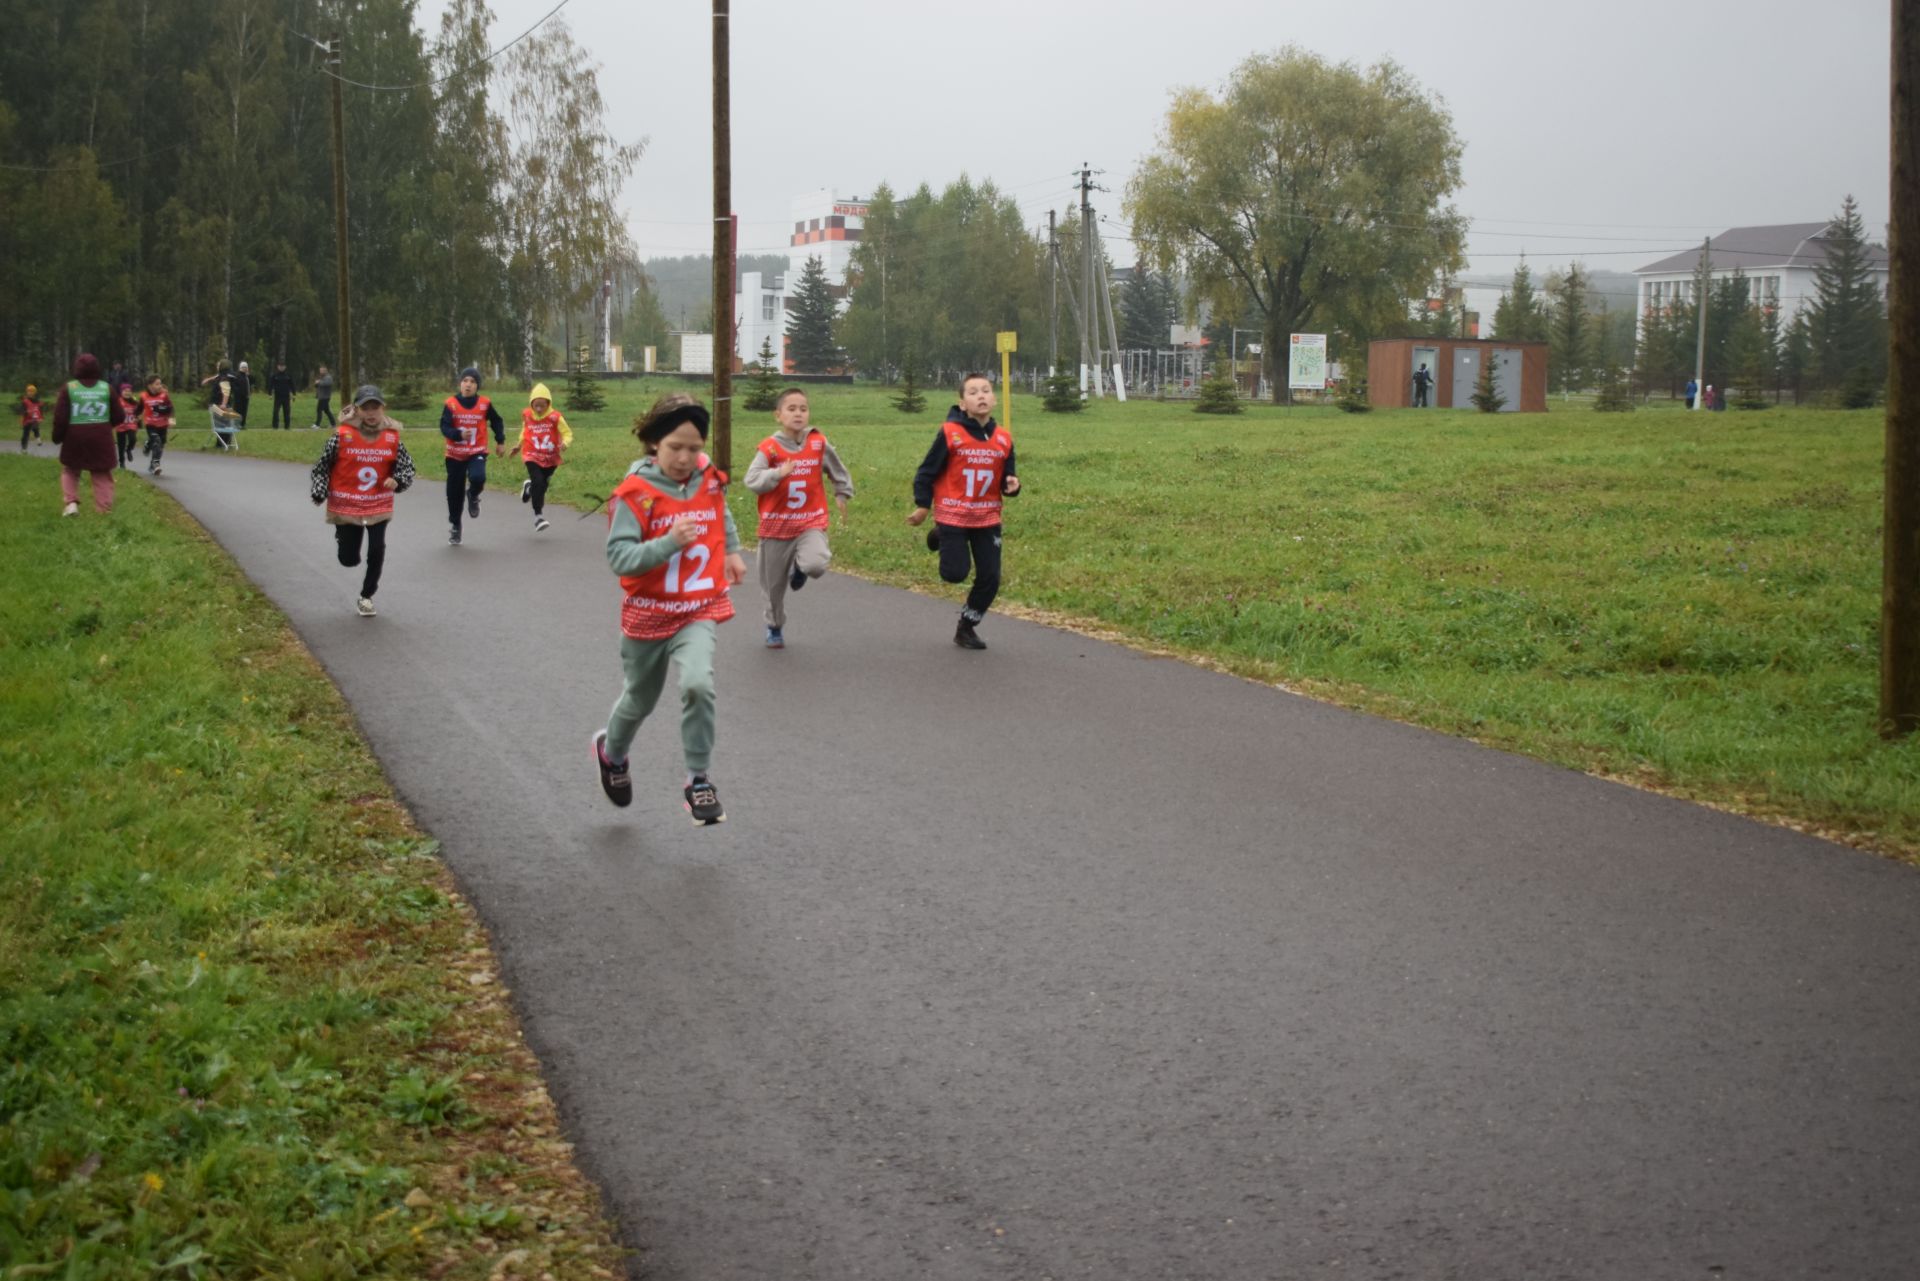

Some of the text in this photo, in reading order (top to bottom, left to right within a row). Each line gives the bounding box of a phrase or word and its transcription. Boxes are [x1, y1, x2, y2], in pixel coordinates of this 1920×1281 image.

[72, 401, 107, 417] 147
[531, 434, 555, 451] 14
[346, 447, 392, 456] ТУКАЕВСКИЙ
[356, 455, 383, 463] РАЙОН
[956, 448, 1004, 459] ТУКАЕВСКИЙ
[967, 456, 994, 465] РАЙОН
[357, 466, 379, 492] 9
[962, 468, 994, 498] 17
[786, 480, 807, 509] 5
[664, 543, 715, 593] 12
